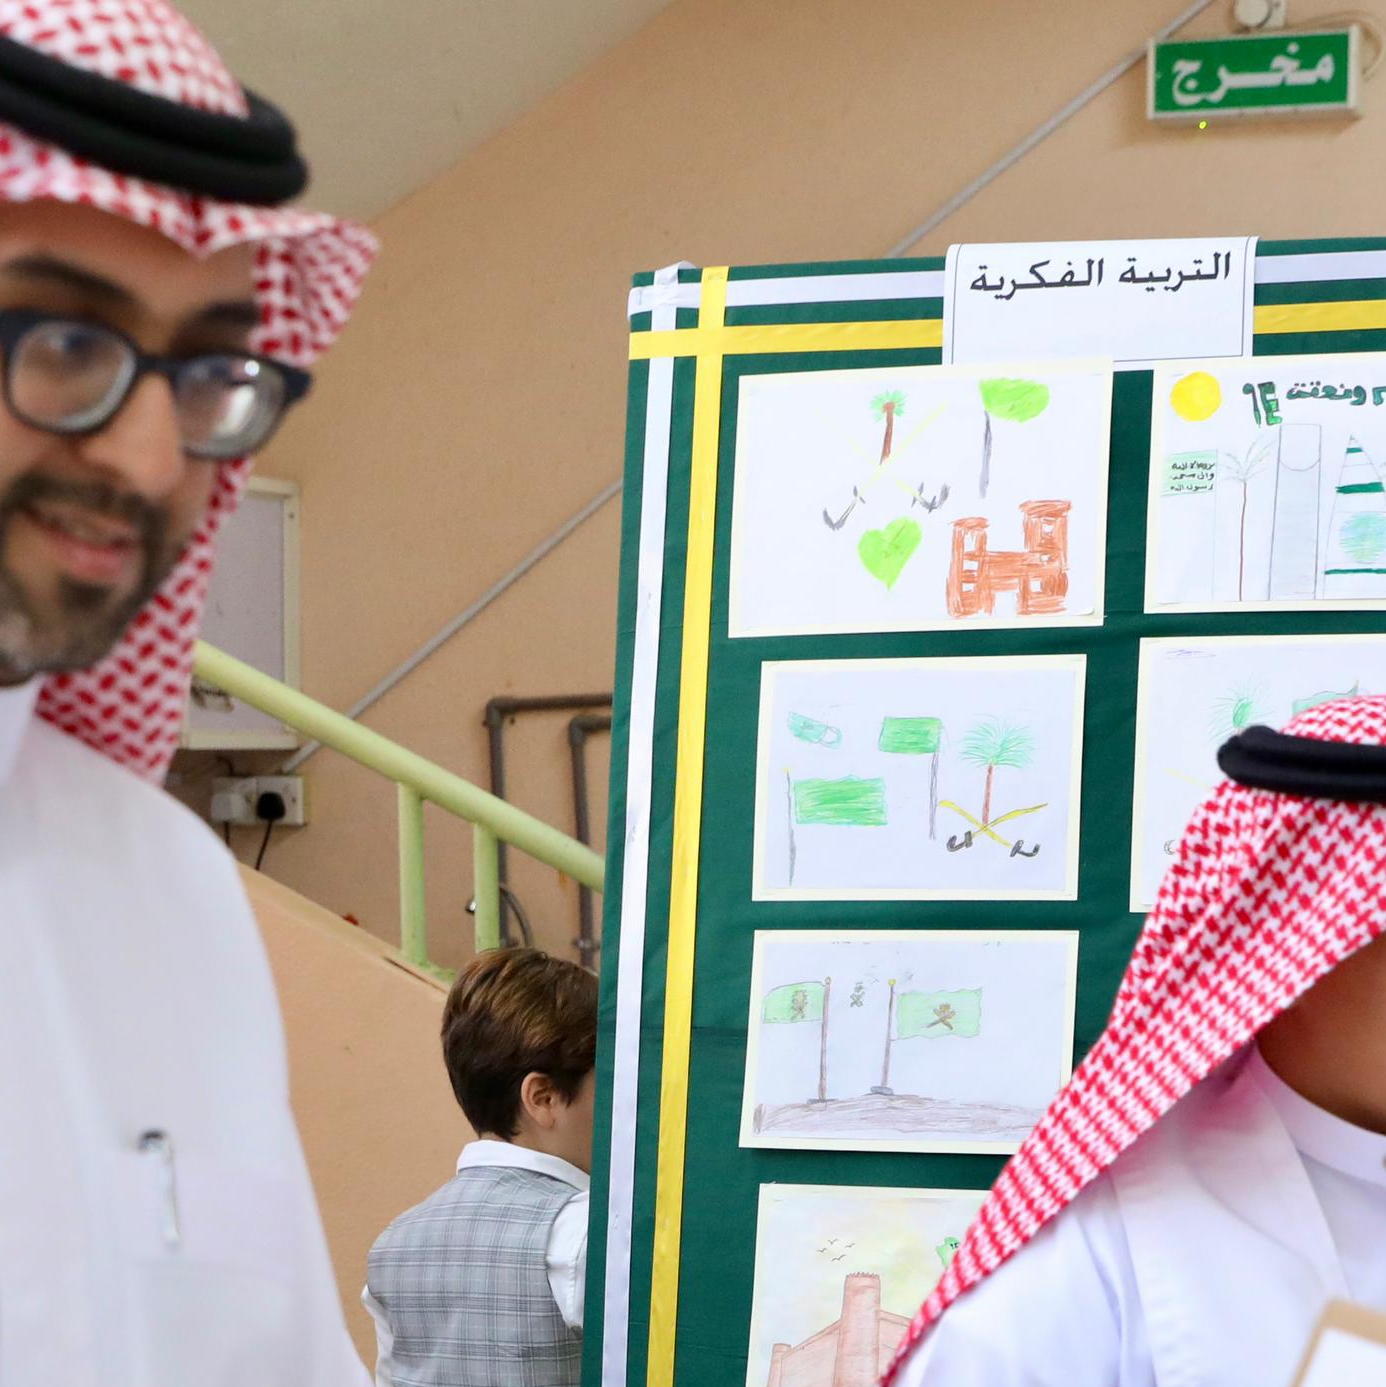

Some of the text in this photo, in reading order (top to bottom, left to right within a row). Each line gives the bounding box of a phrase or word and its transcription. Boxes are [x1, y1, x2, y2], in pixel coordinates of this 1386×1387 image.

[1172, 41, 1335, 106] مخرج
[970, 251, 1231, 300] التربية الفكرية
